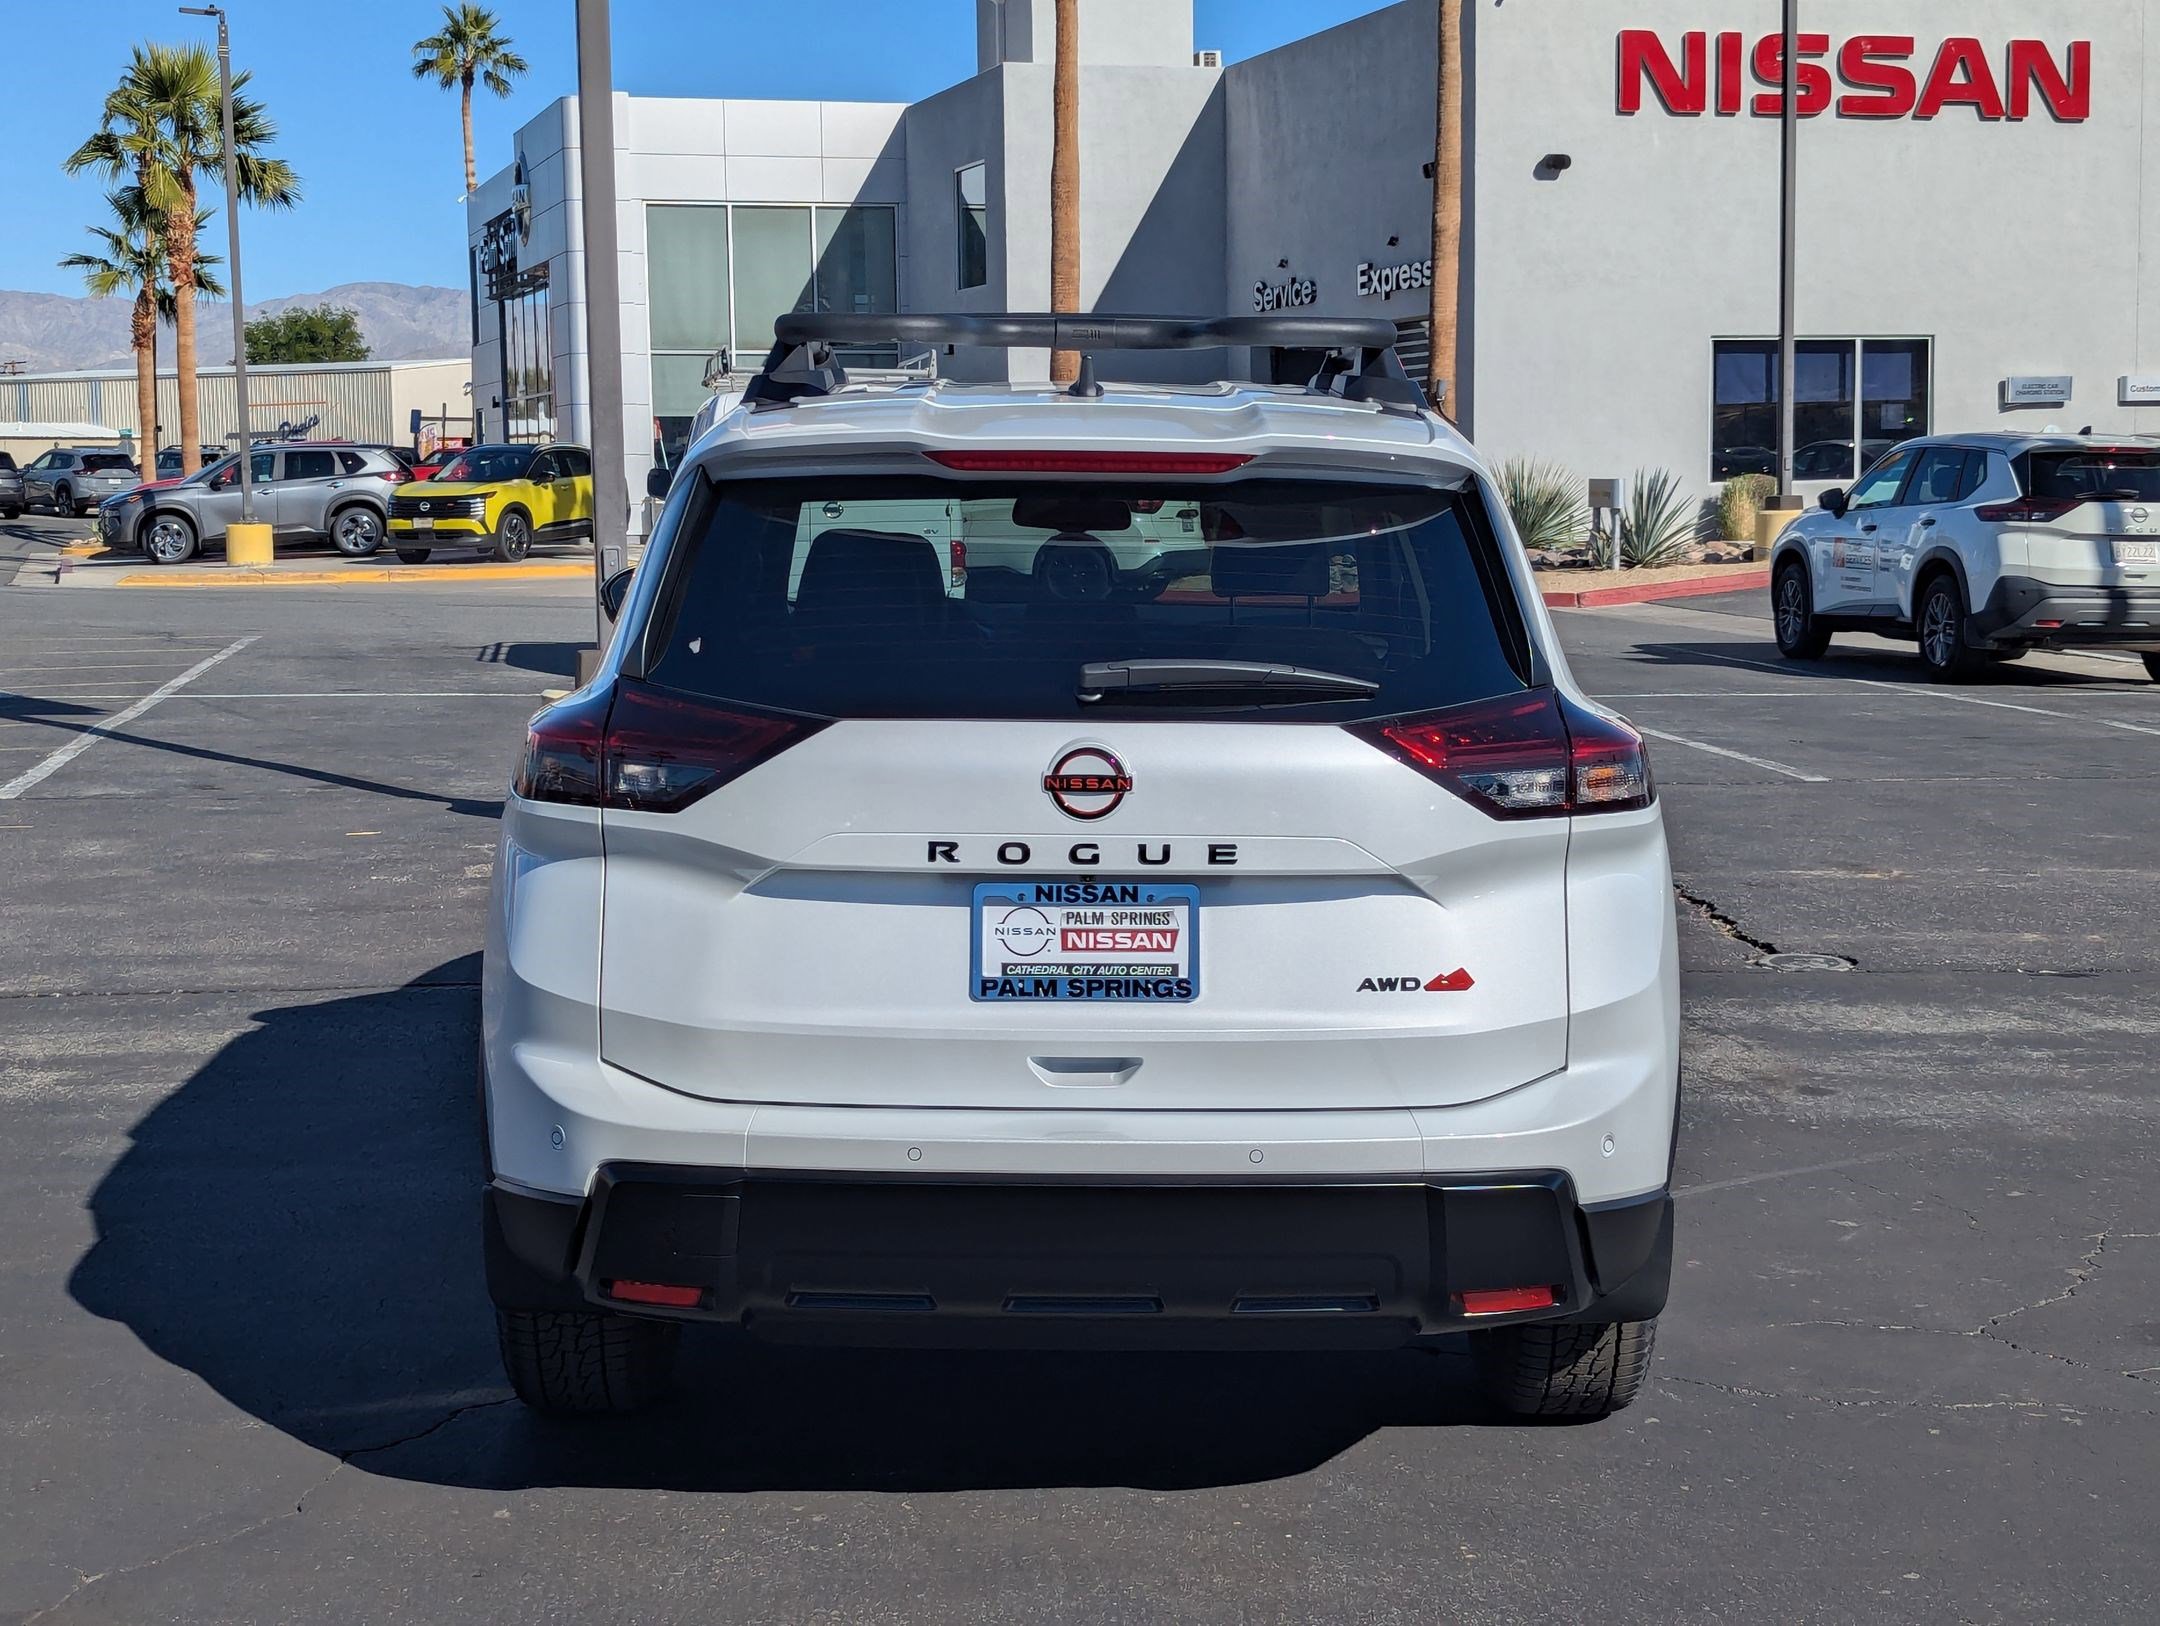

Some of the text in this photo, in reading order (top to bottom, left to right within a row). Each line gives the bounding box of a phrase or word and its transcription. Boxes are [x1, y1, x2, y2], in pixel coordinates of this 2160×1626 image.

[1617, 29, 2091, 120] NISSAN
[1356, 259, 1432, 301] Express
[1253, 277, 1314, 312] Service
[1045, 777, 1132, 791] NISSAN
[927, 841, 1239, 866] ROGUE
[1034, 884, 1139, 904] NISSAN
[1065, 911, 1171, 926] PALM SPRINGS
[994, 927, 1057, 937] NISSAN
[1067, 932, 1173, 949] NISSAN
[1006, 964, 1173, 976] CATHEDRAL CITY AUTO CENTER
[980, 978, 1194, 999] PALM SPRINGS
[1356, 976, 1422, 993] AWD
